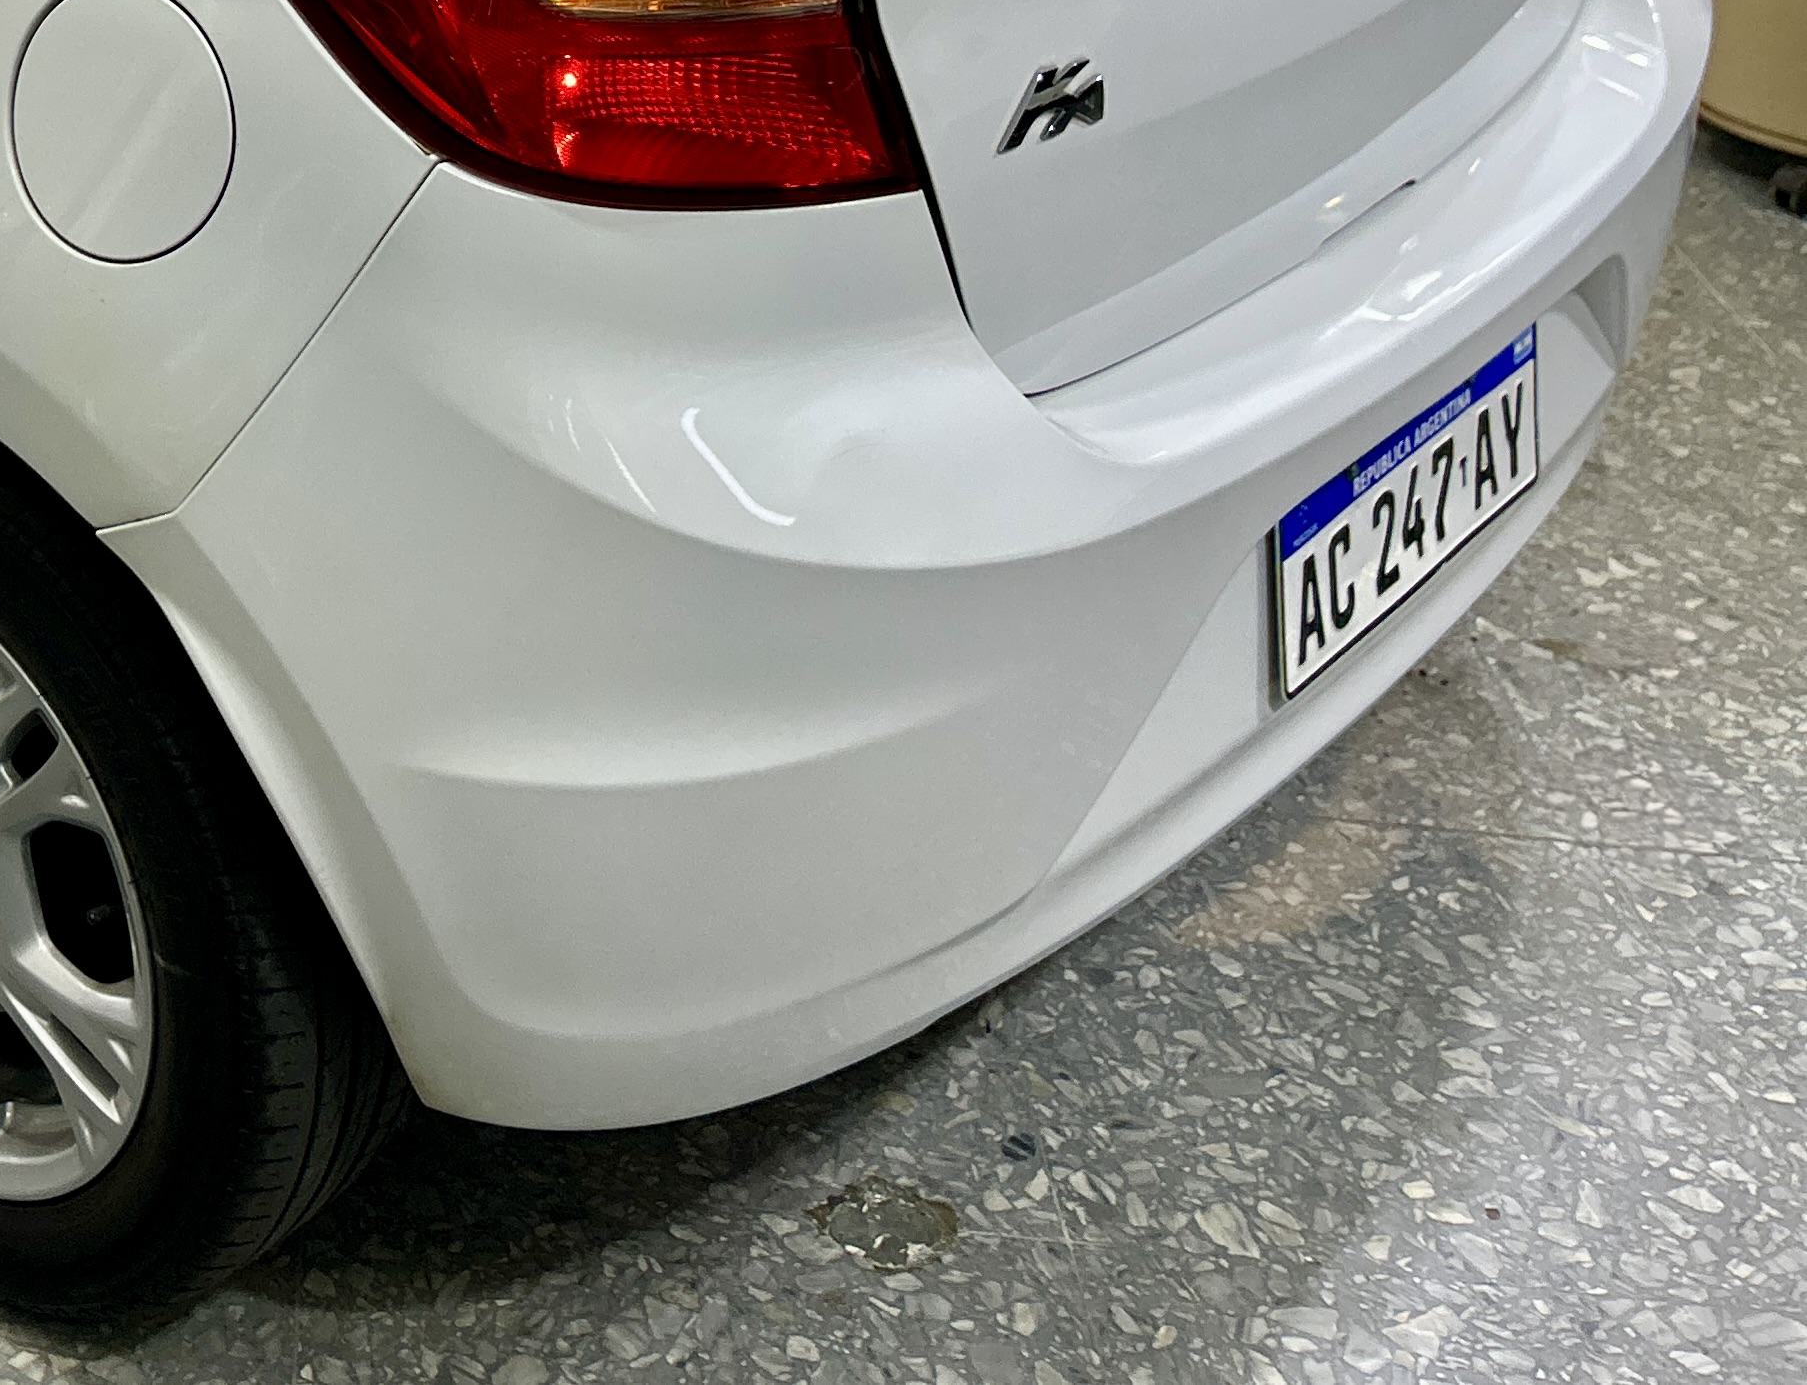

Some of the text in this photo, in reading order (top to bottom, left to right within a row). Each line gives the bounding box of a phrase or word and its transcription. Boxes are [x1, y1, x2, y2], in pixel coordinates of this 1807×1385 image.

[1297, 524, 1356, 667] AC
[1372, 434, 1455, 598] 247
[1474, 379, 1524, 511] AY
[1352, 387, 1472, 498] REPUBLICA ARGENTINA
